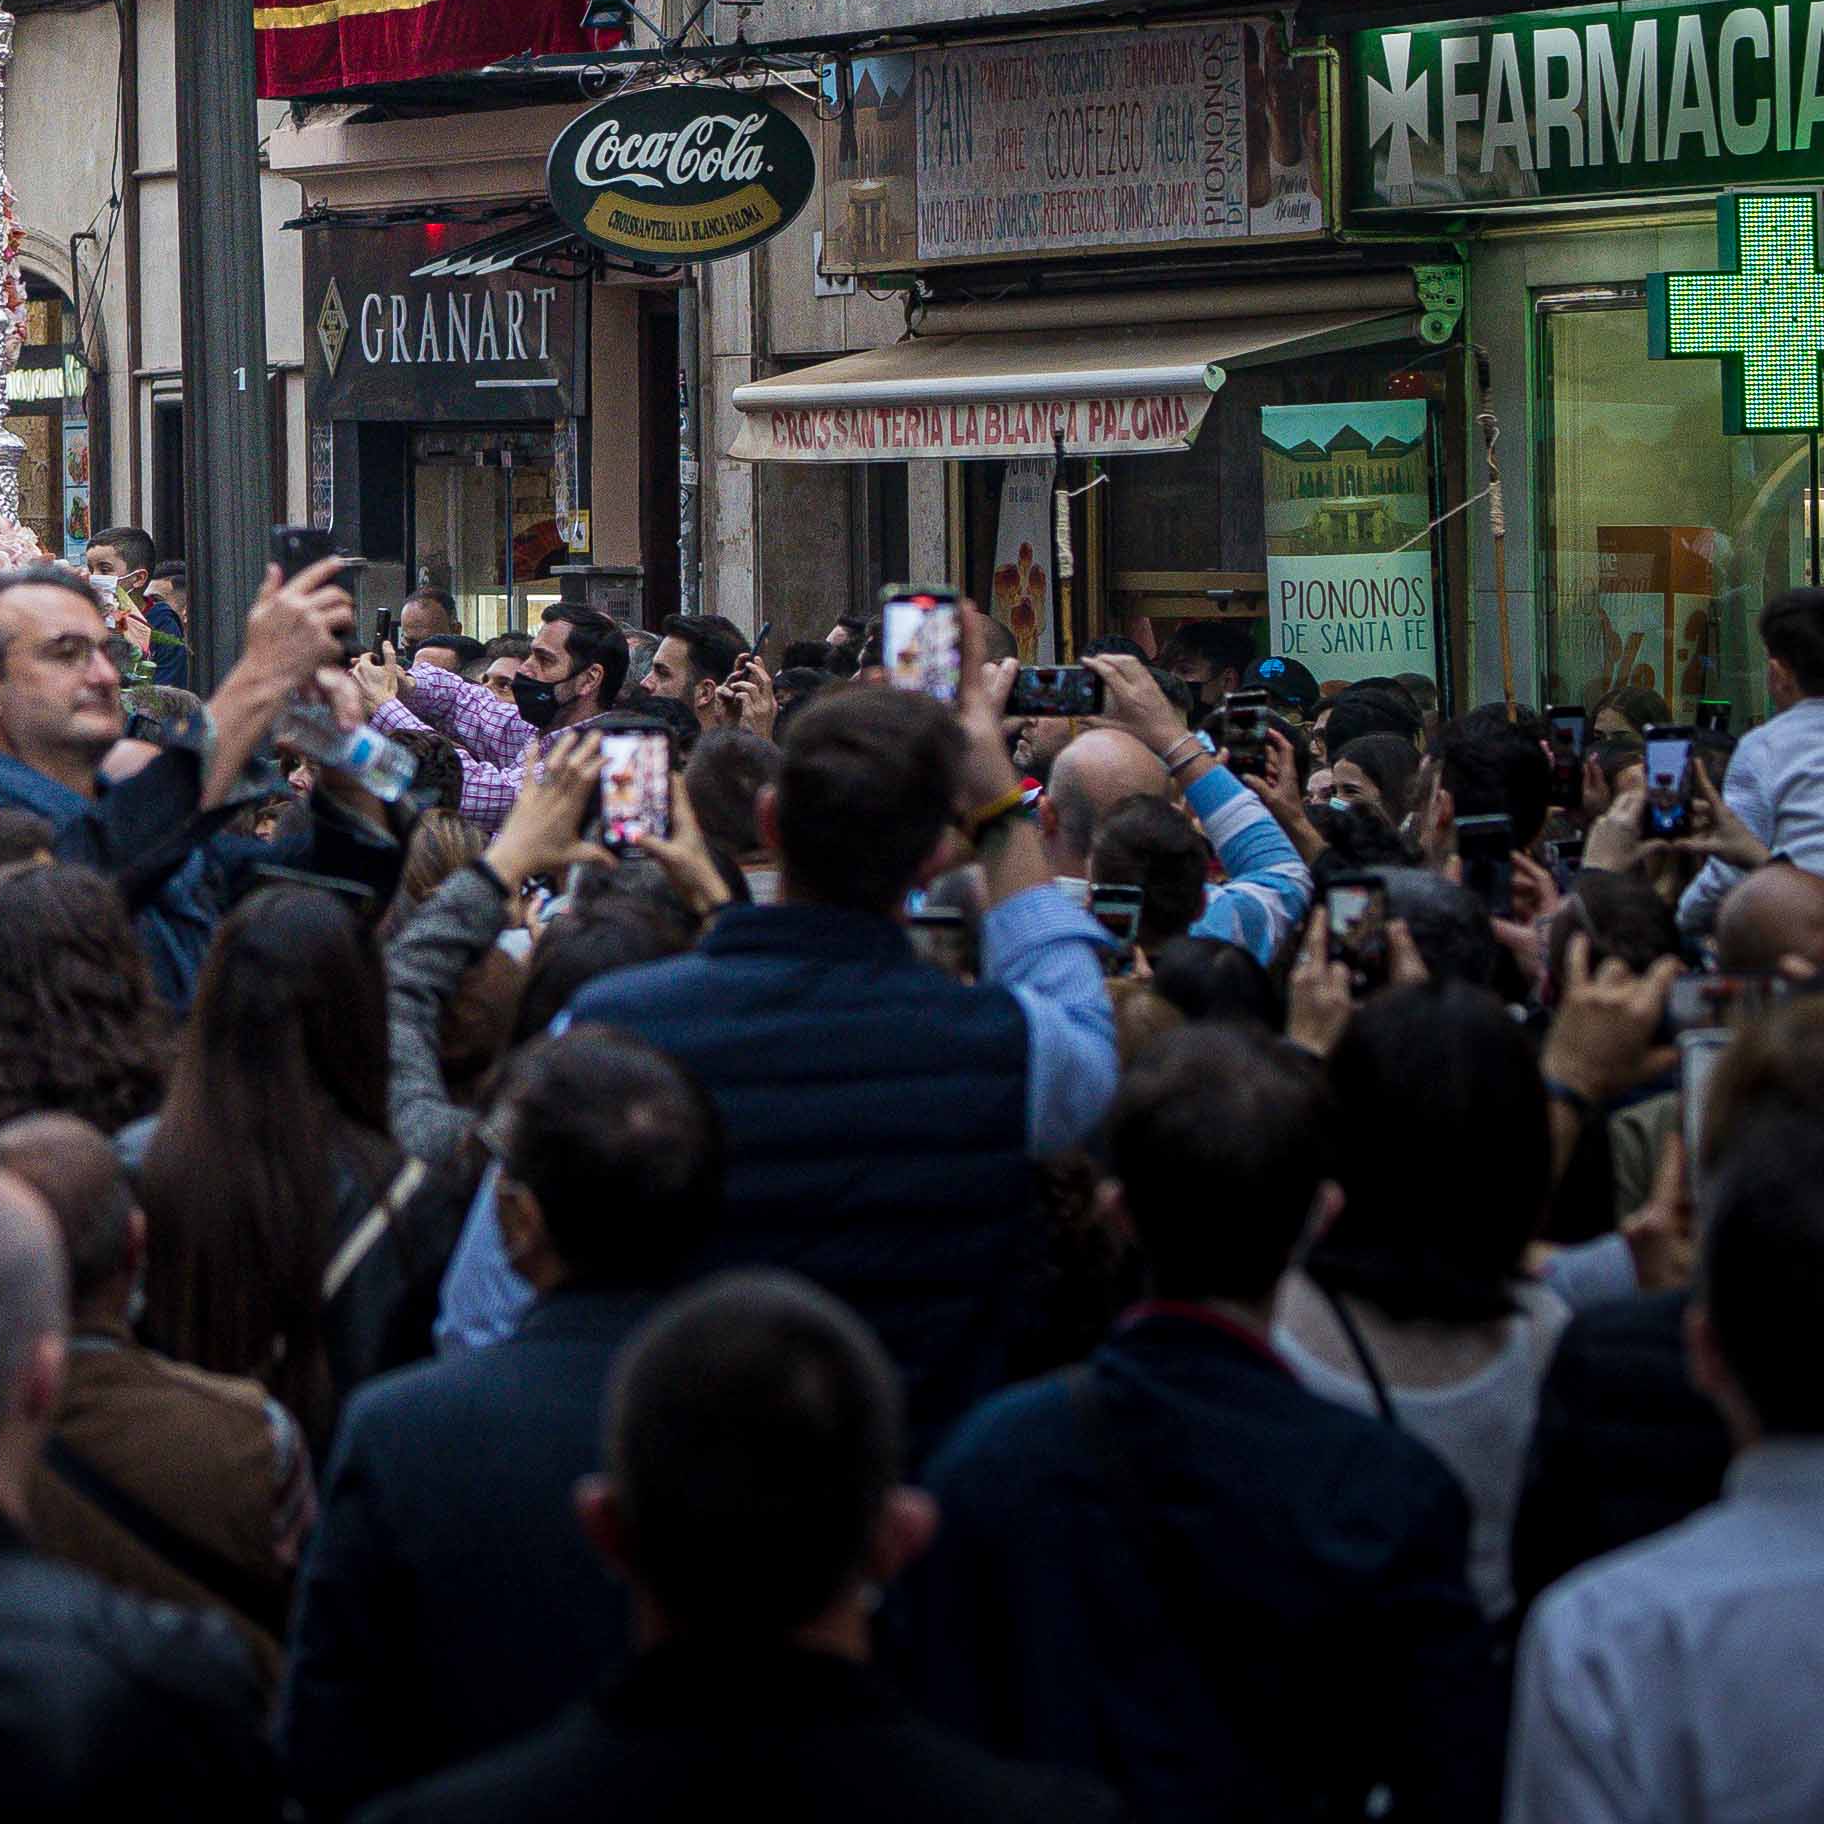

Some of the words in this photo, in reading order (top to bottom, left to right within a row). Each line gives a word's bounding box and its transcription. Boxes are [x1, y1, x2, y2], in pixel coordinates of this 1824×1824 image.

[575, 113, 768, 188] Coca-Cola
[921, 62, 973, 171] PAN
[1044, 100, 1145, 180] COOFE2GO
[1154, 103, 1197, 164] AGUA
[1203, 33, 1225, 227] PIONONOS
[1224, 79, 1243, 174] SANTA
[607, 209, 677, 242] CROISSANTERIA
[678, 222, 692, 241] LA
[692, 215, 725, 240] BLANCA
[726, 204, 764, 234] PALOMA
[921, 198, 994, 244] NAPOLITANAS
[996, 191, 1038, 239] SNACKS
[1043, 189, 1106, 236] REFRESCOS
[1113, 182, 1153, 232] DRINKS
[1156, 181, 1198, 227] ZUMOS
[1226, 192, 1243, 226] DE
[360, 287, 556, 364] GRANART
[772, 406, 943, 450] CROISSANTERIA
[950, 405, 980, 446] LA
[984, 399, 1079, 446] BLANCA
[1088, 396, 1189, 443] PALOMA
[1281, 577, 1426, 621] PIONONOS
[1281, 623, 1308, 654] DE
[1321, 620, 1393, 654] SANTA
[1405, 619, 1428, 651] FE
